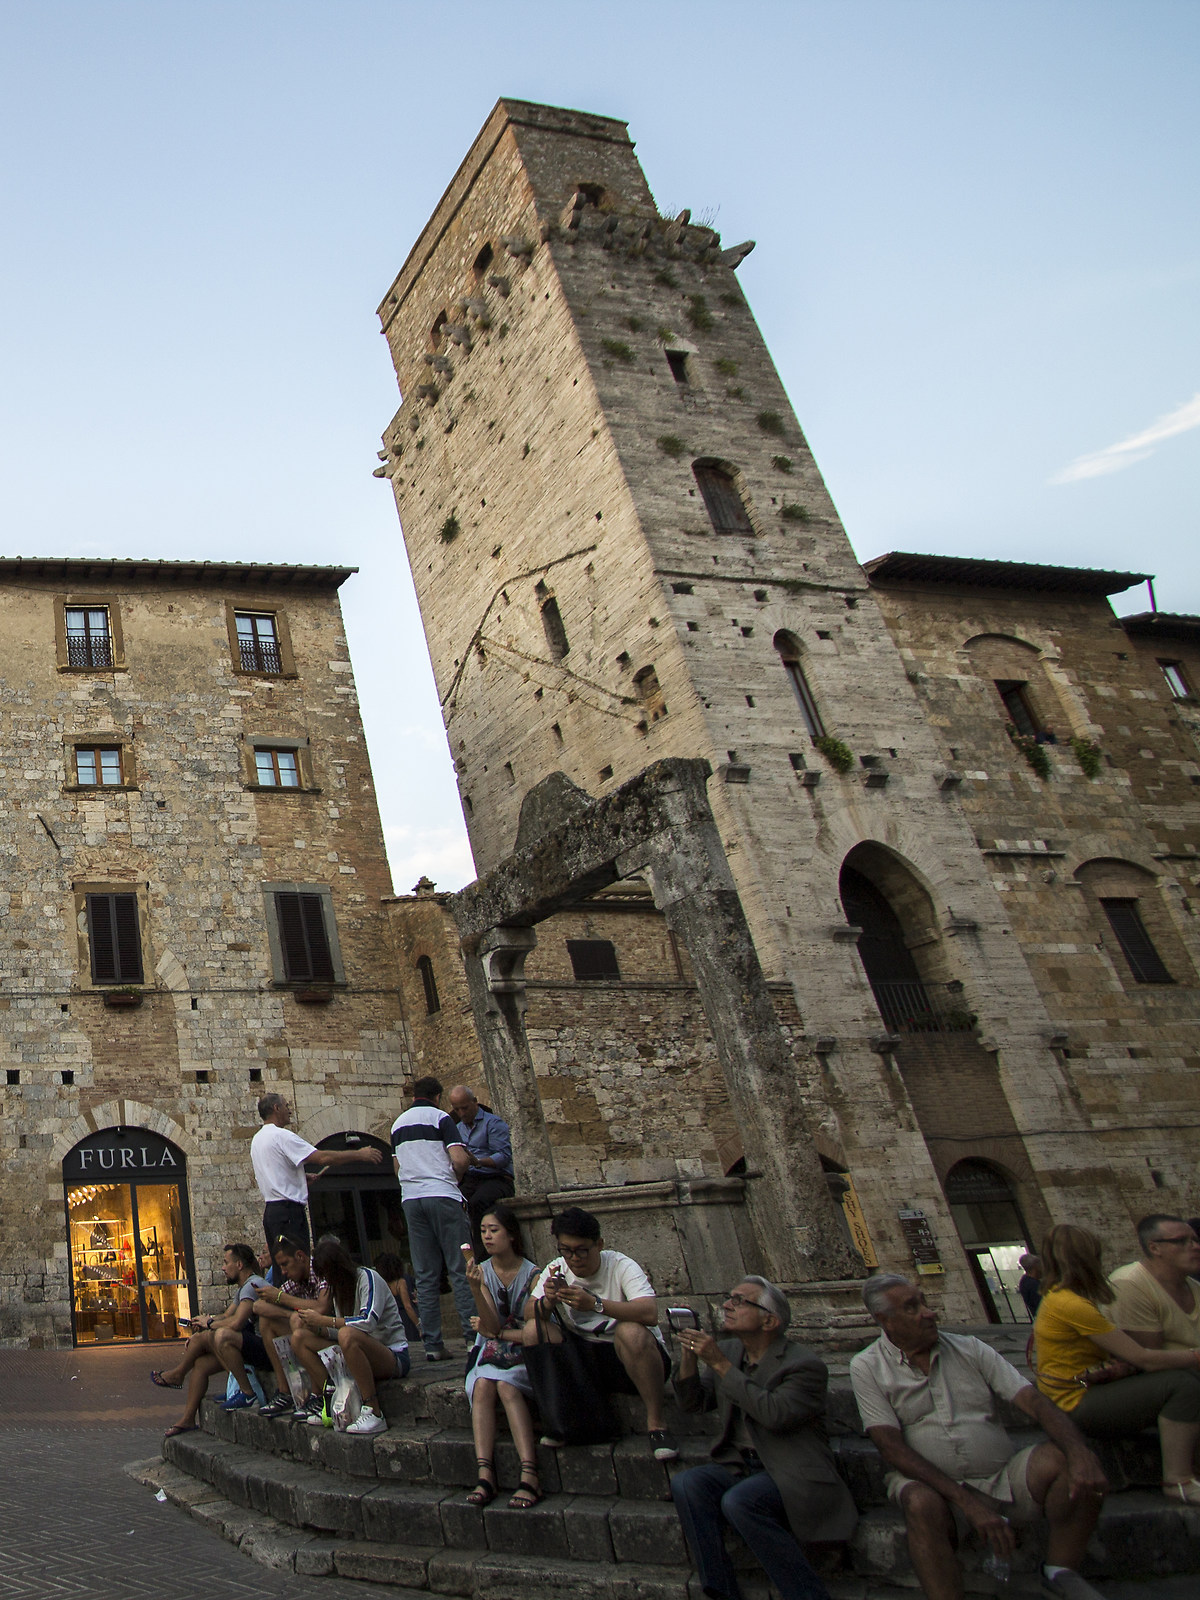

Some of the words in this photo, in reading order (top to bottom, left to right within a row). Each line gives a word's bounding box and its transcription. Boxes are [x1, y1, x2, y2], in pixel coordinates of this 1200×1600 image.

[79, 1146, 177, 1170] FURLA
[844, 1191, 857, 1218] SHY
[853, 1221, 872, 1265] SHOES
